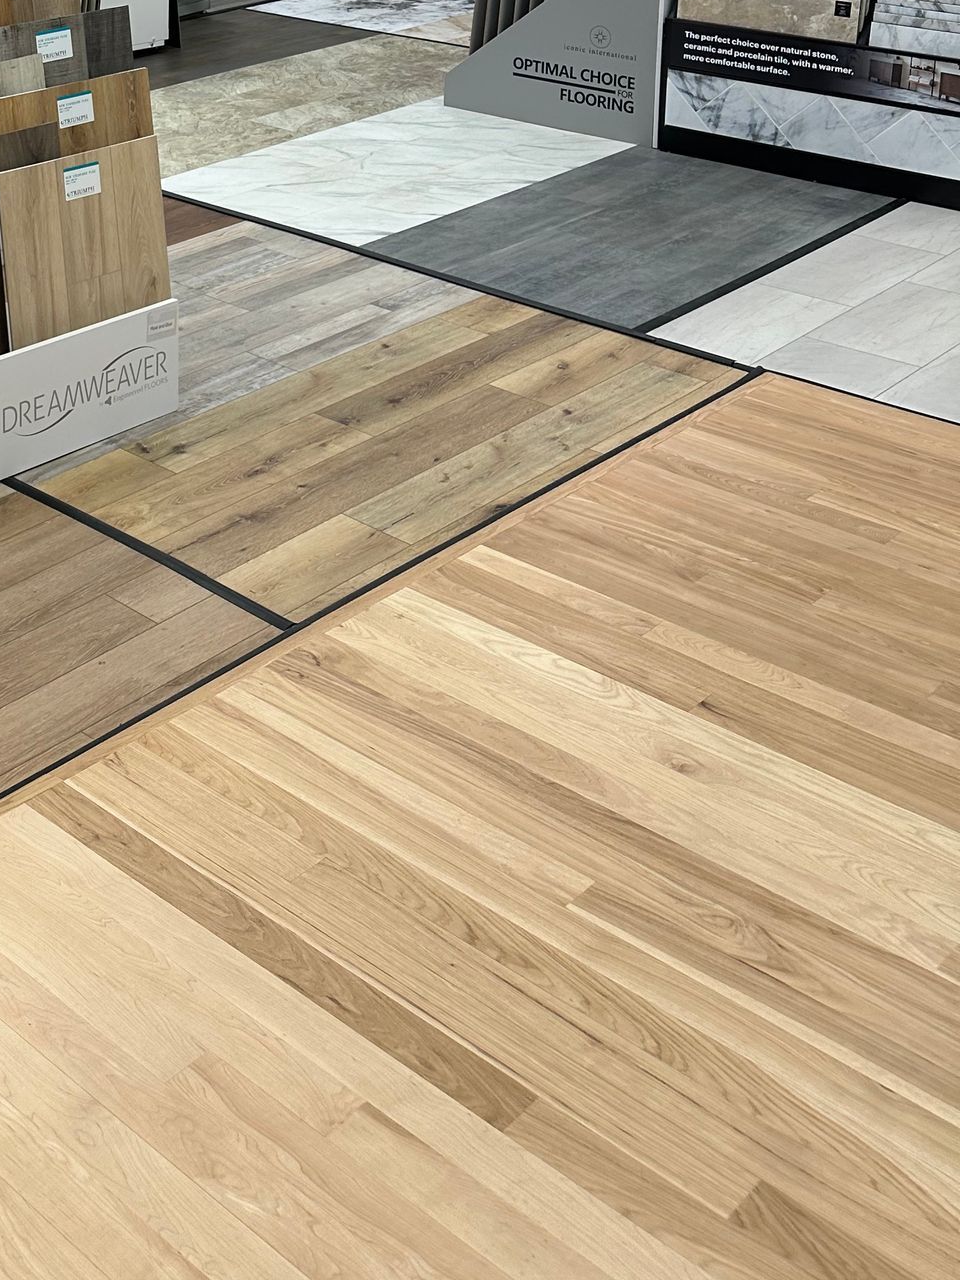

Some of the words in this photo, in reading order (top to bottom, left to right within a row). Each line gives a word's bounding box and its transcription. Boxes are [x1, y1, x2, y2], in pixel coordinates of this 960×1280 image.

[563, 43, 586, 53] iconic
[588, 48, 637, 61] international
[683, 42, 716, 53] ceramic
[717, 48, 733, 56] and
[734, 50, 773, 62] porcelain
[774, 55, 790, 66] tile,
[791, 59, 811, 68] with
[819, 63, 854, 76] warmer,
[684, 30, 700, 40] The
[701, 34, 731, 45] perfect
[731, 38, 760, 49] choice
[760, 43, 780, 52] over
[780, 46, 811, 57] natural
[812, 51, 839, 61] stone,
[513, 57, 577, 80] OPTIMAL
[580, 68, 636, 90] CHOICE
[683, 53, 704, 62] more
[705, 57, 756, 70] comfortable
[756, 65, 791, 76] surface.
[560, 88, 634, 114] FLOORING
[617, 89, 633, 99] FOR
[2, 351, 167, 433] DREAMWEAVER
